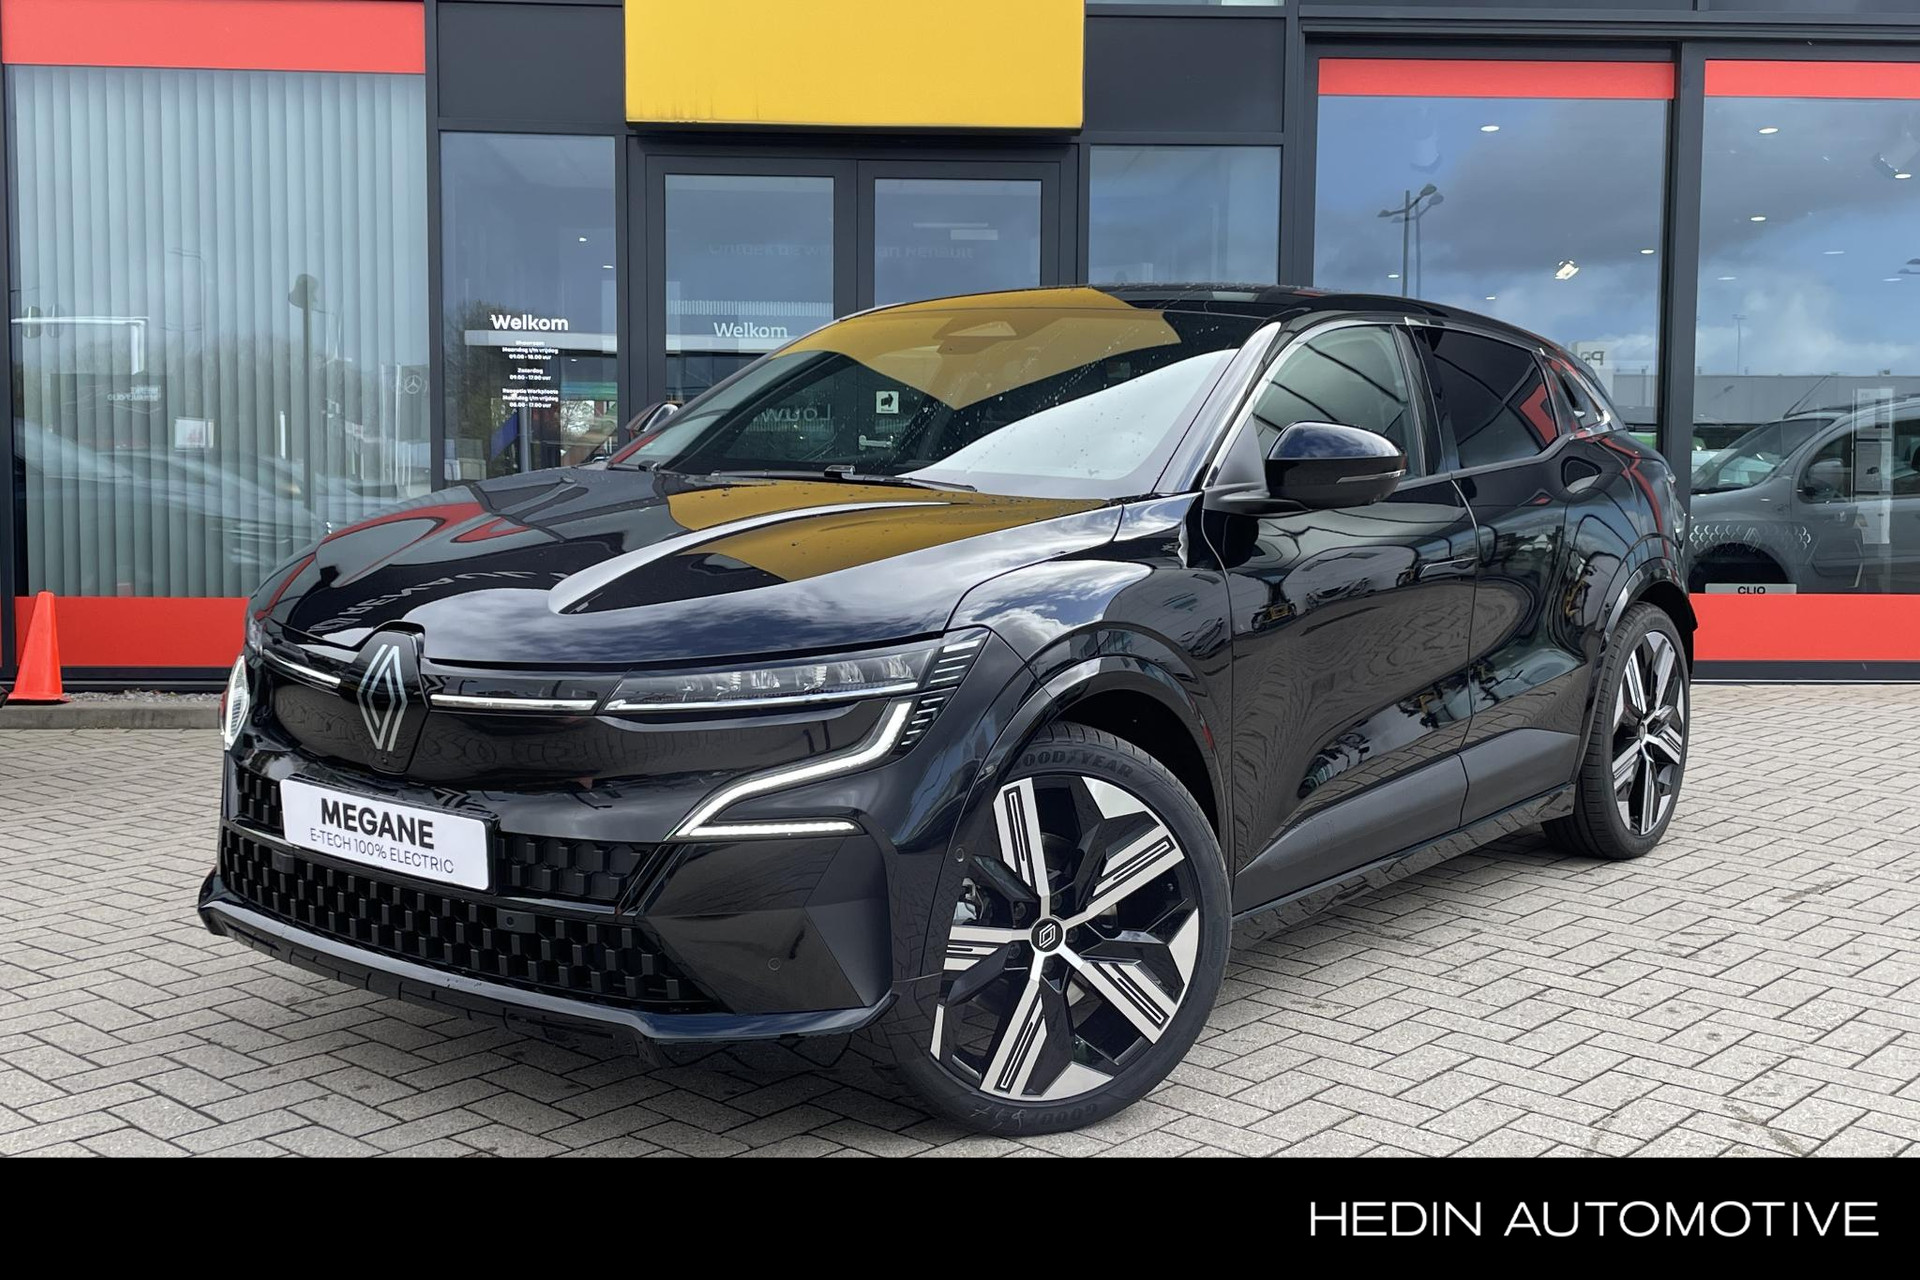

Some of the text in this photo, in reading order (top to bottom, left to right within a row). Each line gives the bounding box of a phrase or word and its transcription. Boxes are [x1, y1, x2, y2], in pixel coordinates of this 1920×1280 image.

[491, 314, 569, 331] Welkom
[713, 322, 788, 338] Welkom
[1738, 586, 1766, 595] CLIO
[321, 798, 435, 850] MEGANE
[310, 827, 454, 874] E-TECH 100% ELECTRIC
